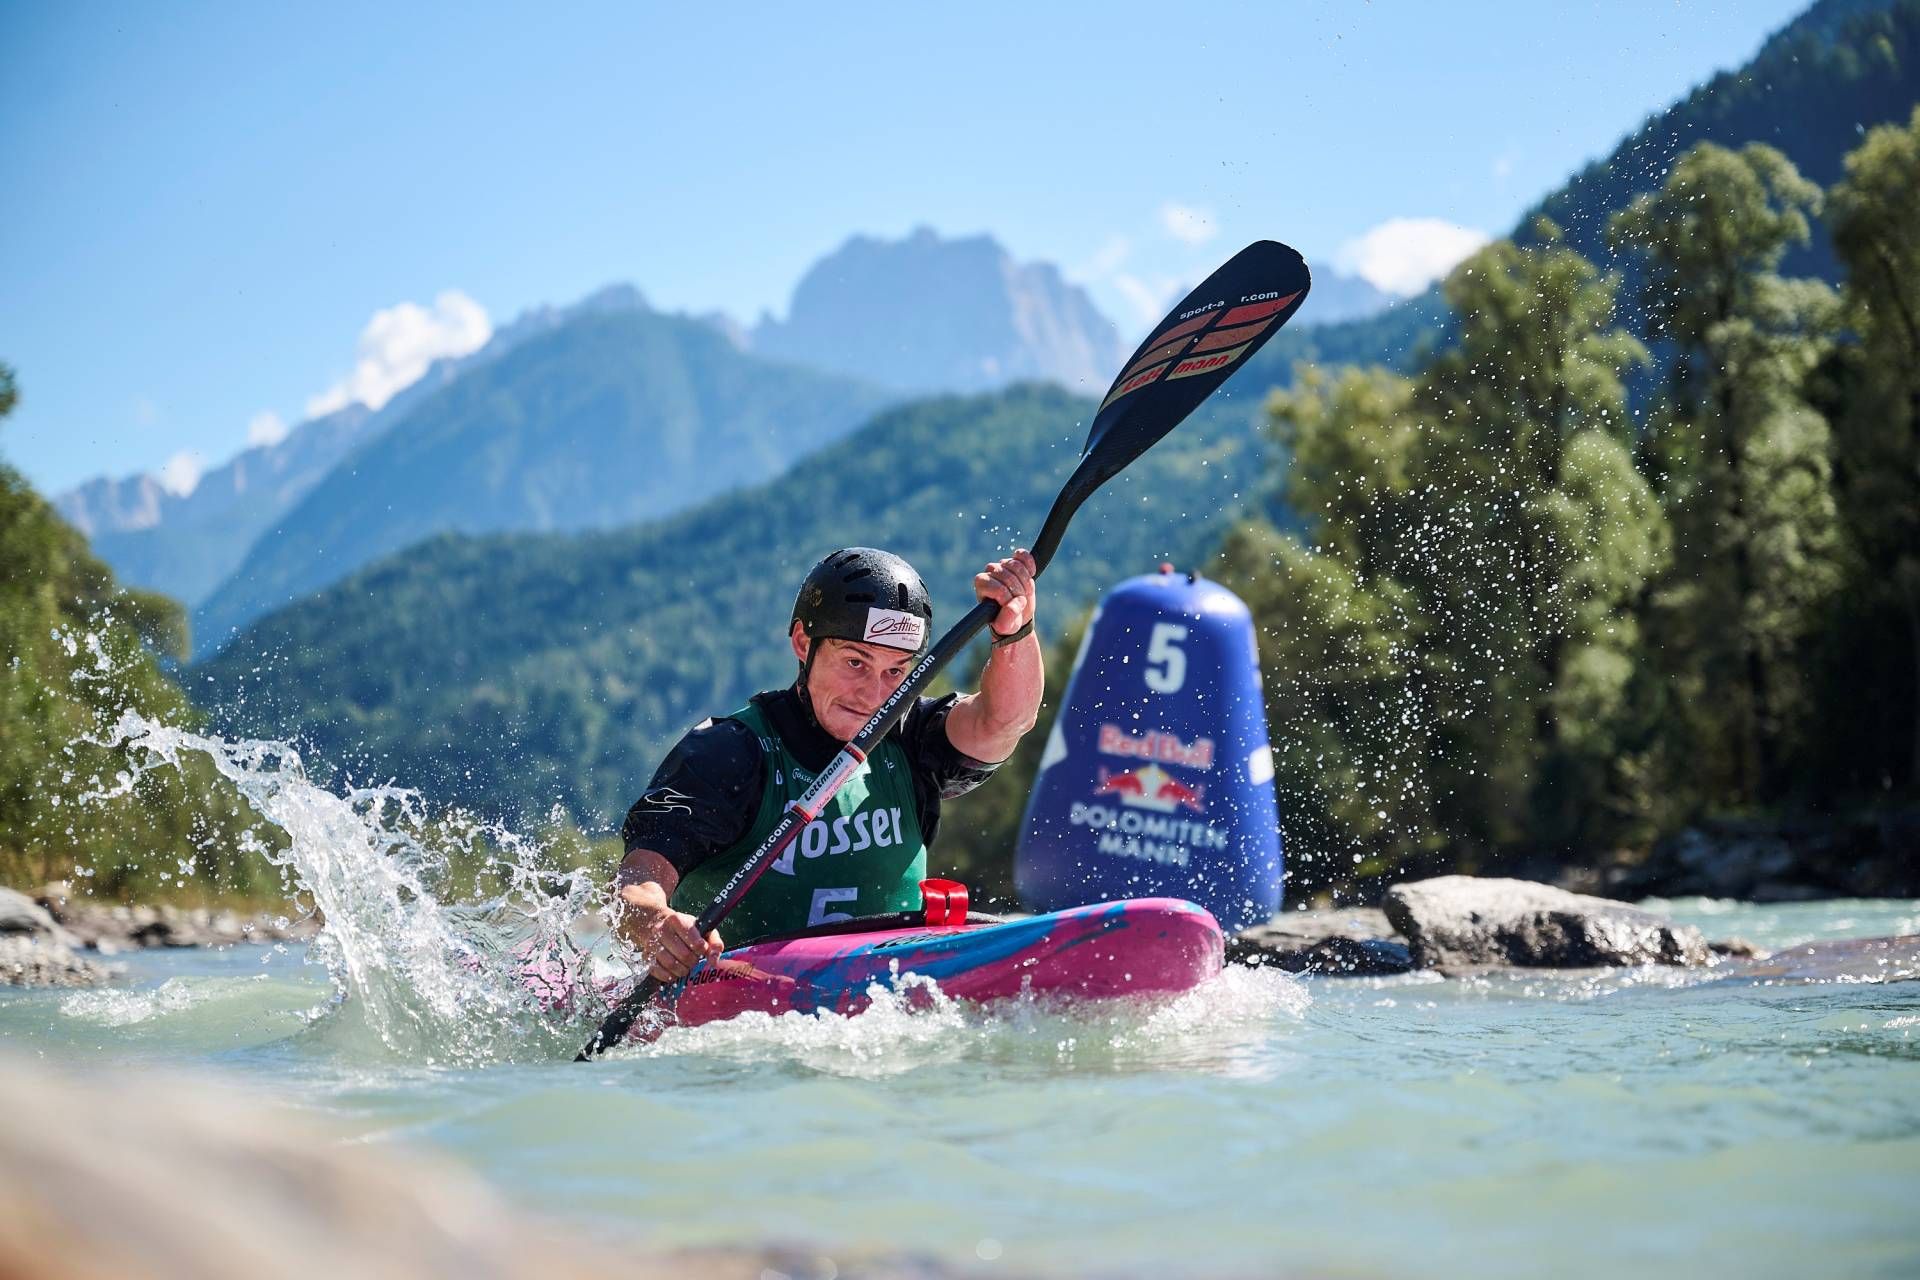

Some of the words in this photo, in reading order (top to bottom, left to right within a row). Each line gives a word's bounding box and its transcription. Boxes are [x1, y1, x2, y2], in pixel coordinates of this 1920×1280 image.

[857, 653, 936, 740] sport-auer.com
[1144, 622, 1187, 694] 5
[803, 756, 844, 801] Lettmann
[713, 817, 793, 904] sport-auer.com
